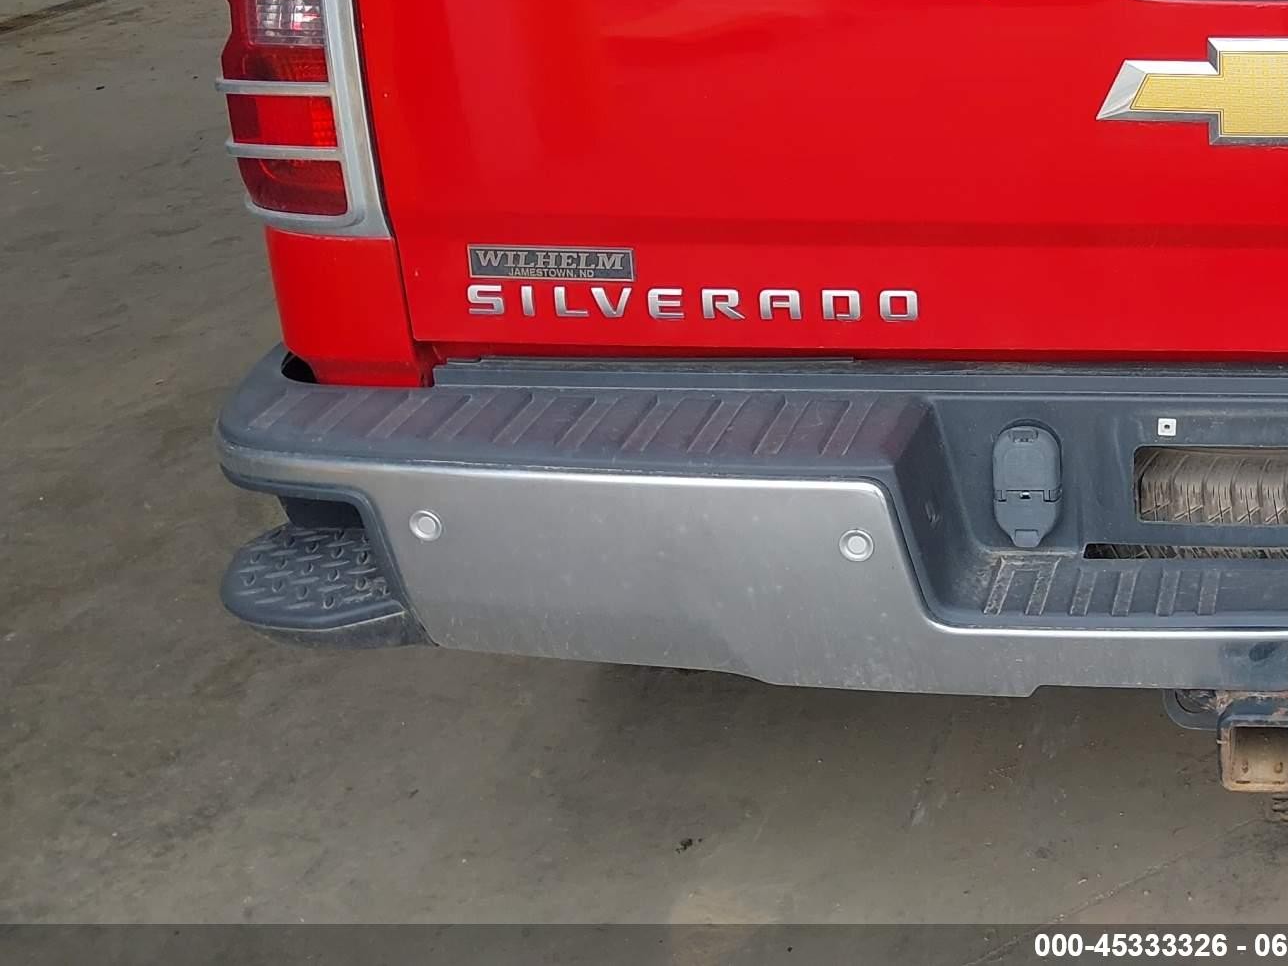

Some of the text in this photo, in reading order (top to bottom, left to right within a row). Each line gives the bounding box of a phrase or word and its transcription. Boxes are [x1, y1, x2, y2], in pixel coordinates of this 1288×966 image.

[475, 250, 625, 270] WILHELM
[579, 269, 595, 278] ND
[466, 284, 919, 322] SILVERADO
